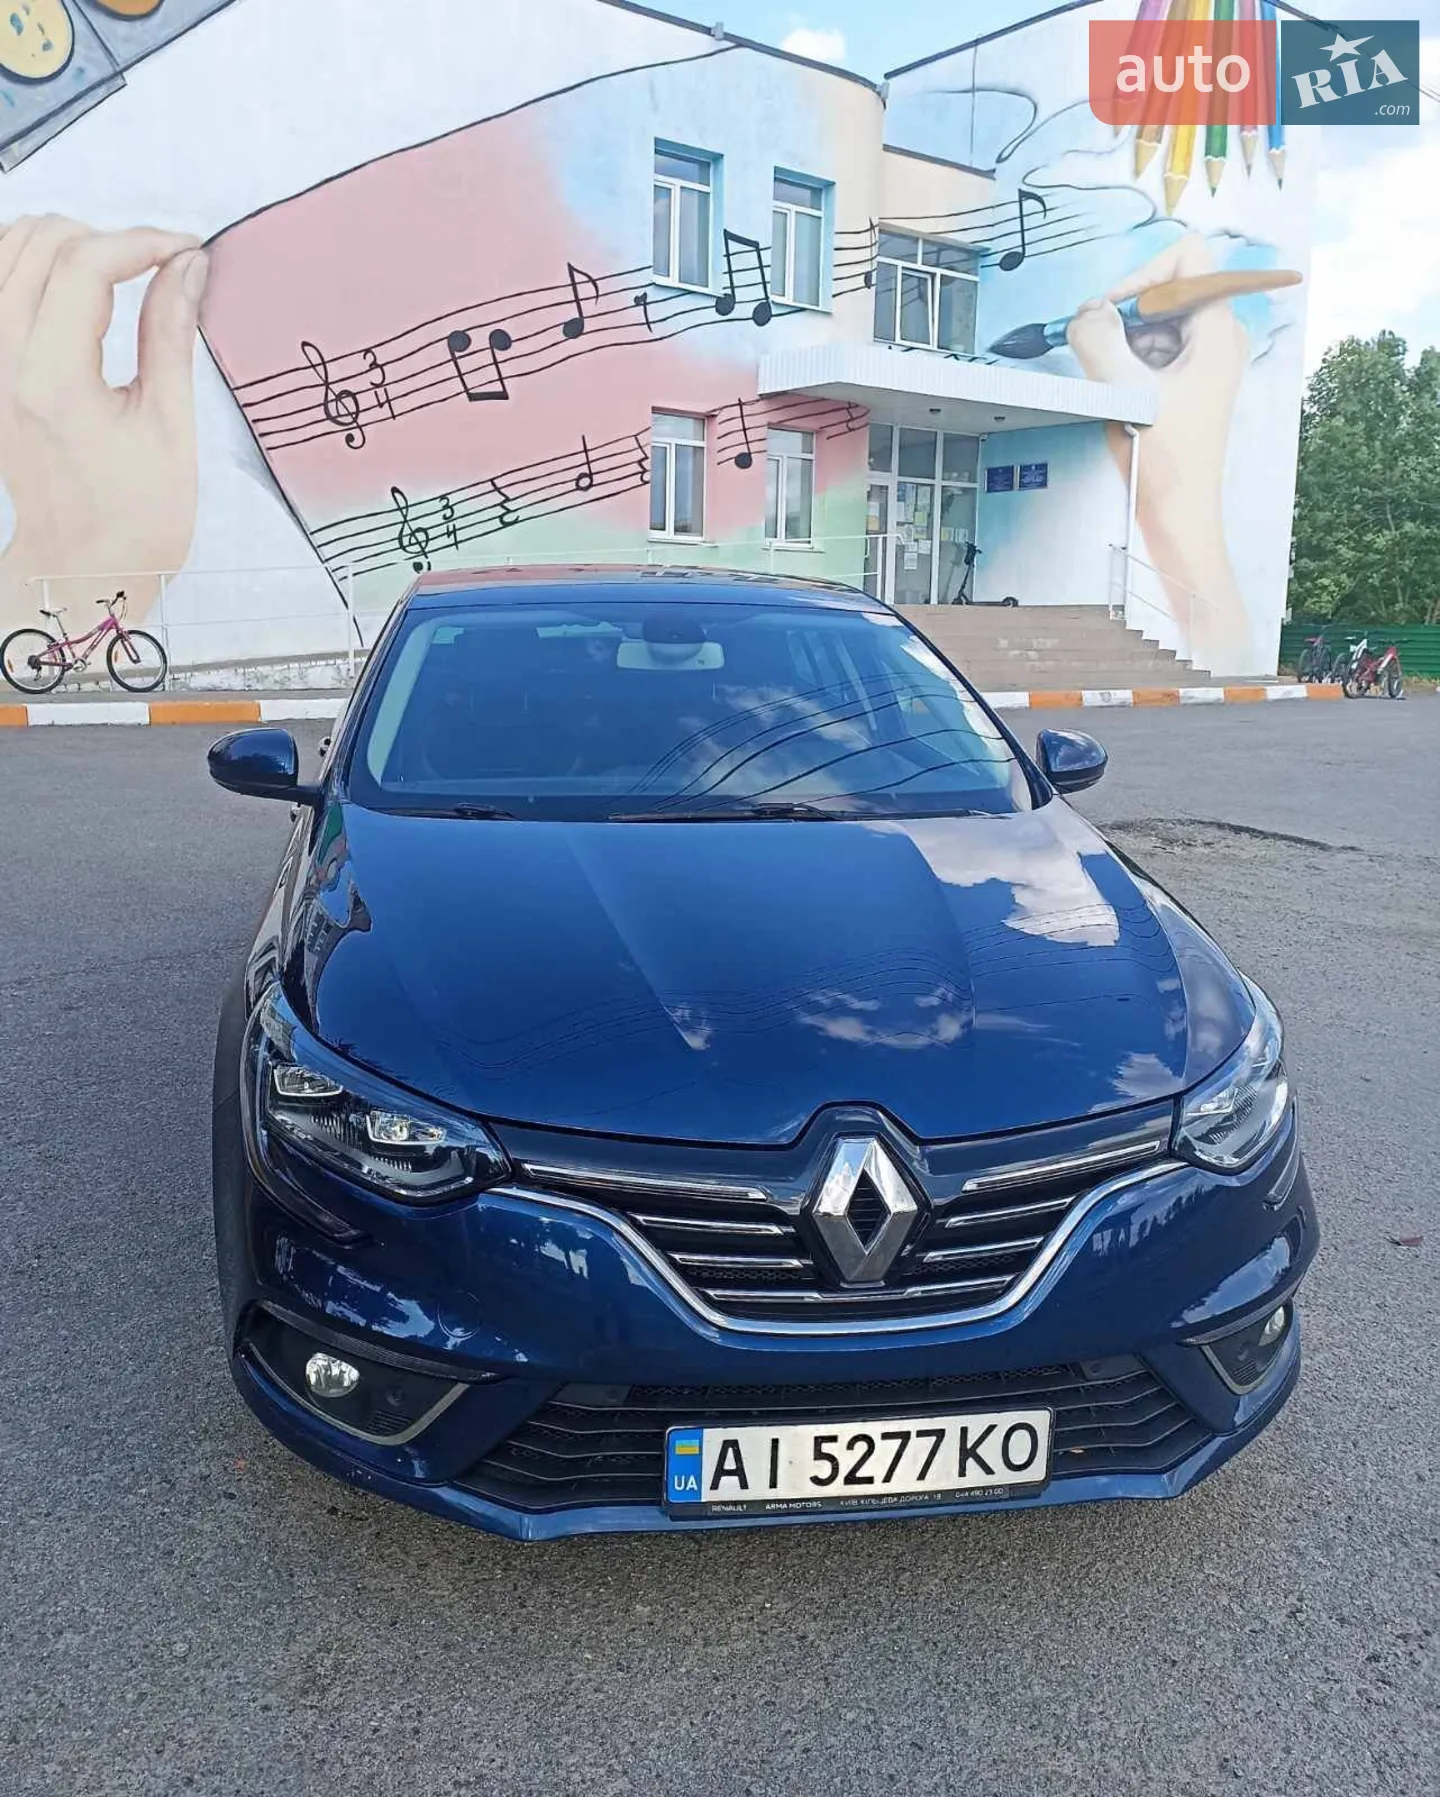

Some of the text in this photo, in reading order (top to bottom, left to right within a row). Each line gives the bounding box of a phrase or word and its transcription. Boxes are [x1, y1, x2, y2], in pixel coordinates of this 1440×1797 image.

[709, 1422, 1040, 1491] AI 5277 KO
[673, 1475, 698, 1491] UA
[711, 1501, 822, 1512] RENAULT ARMA MOTORS
